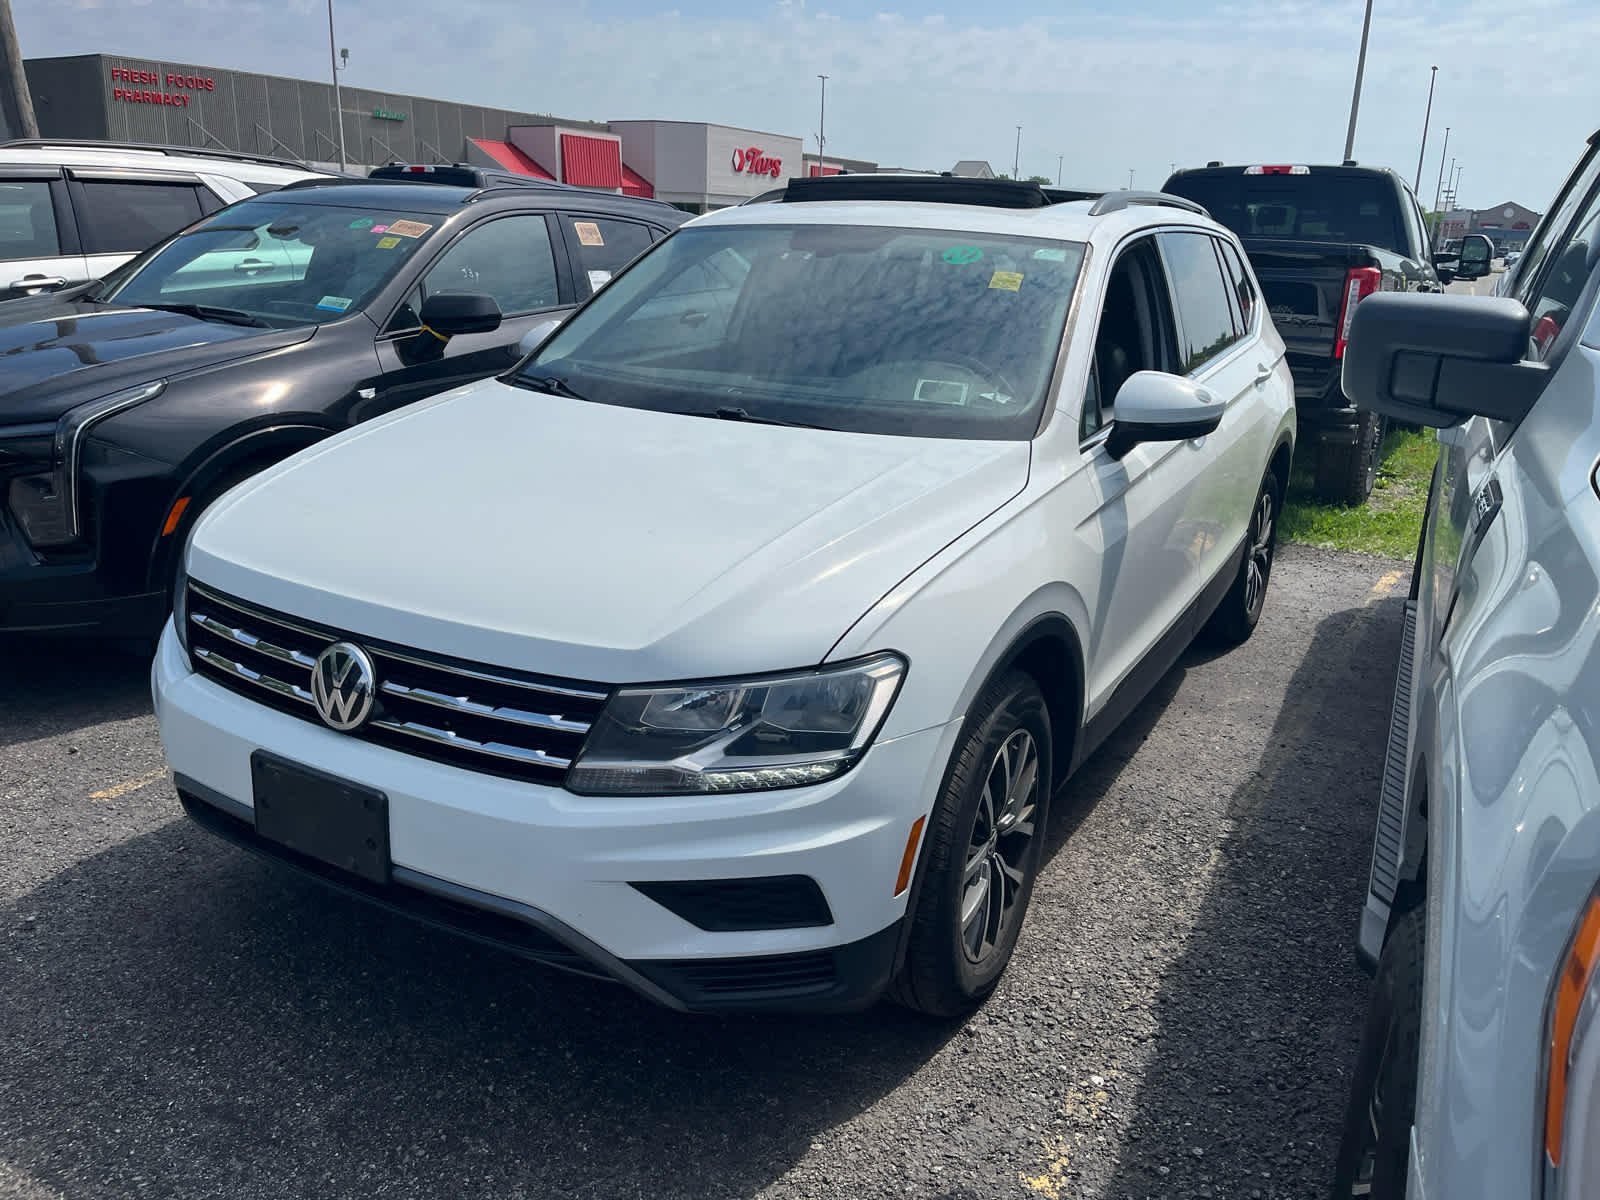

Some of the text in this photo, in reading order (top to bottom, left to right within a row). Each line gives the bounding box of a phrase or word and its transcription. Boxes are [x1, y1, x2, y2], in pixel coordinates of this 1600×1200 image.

[112, 67, 215, 92] FRESH FOODS
[113, 87, 190, 107] PHARMACY
